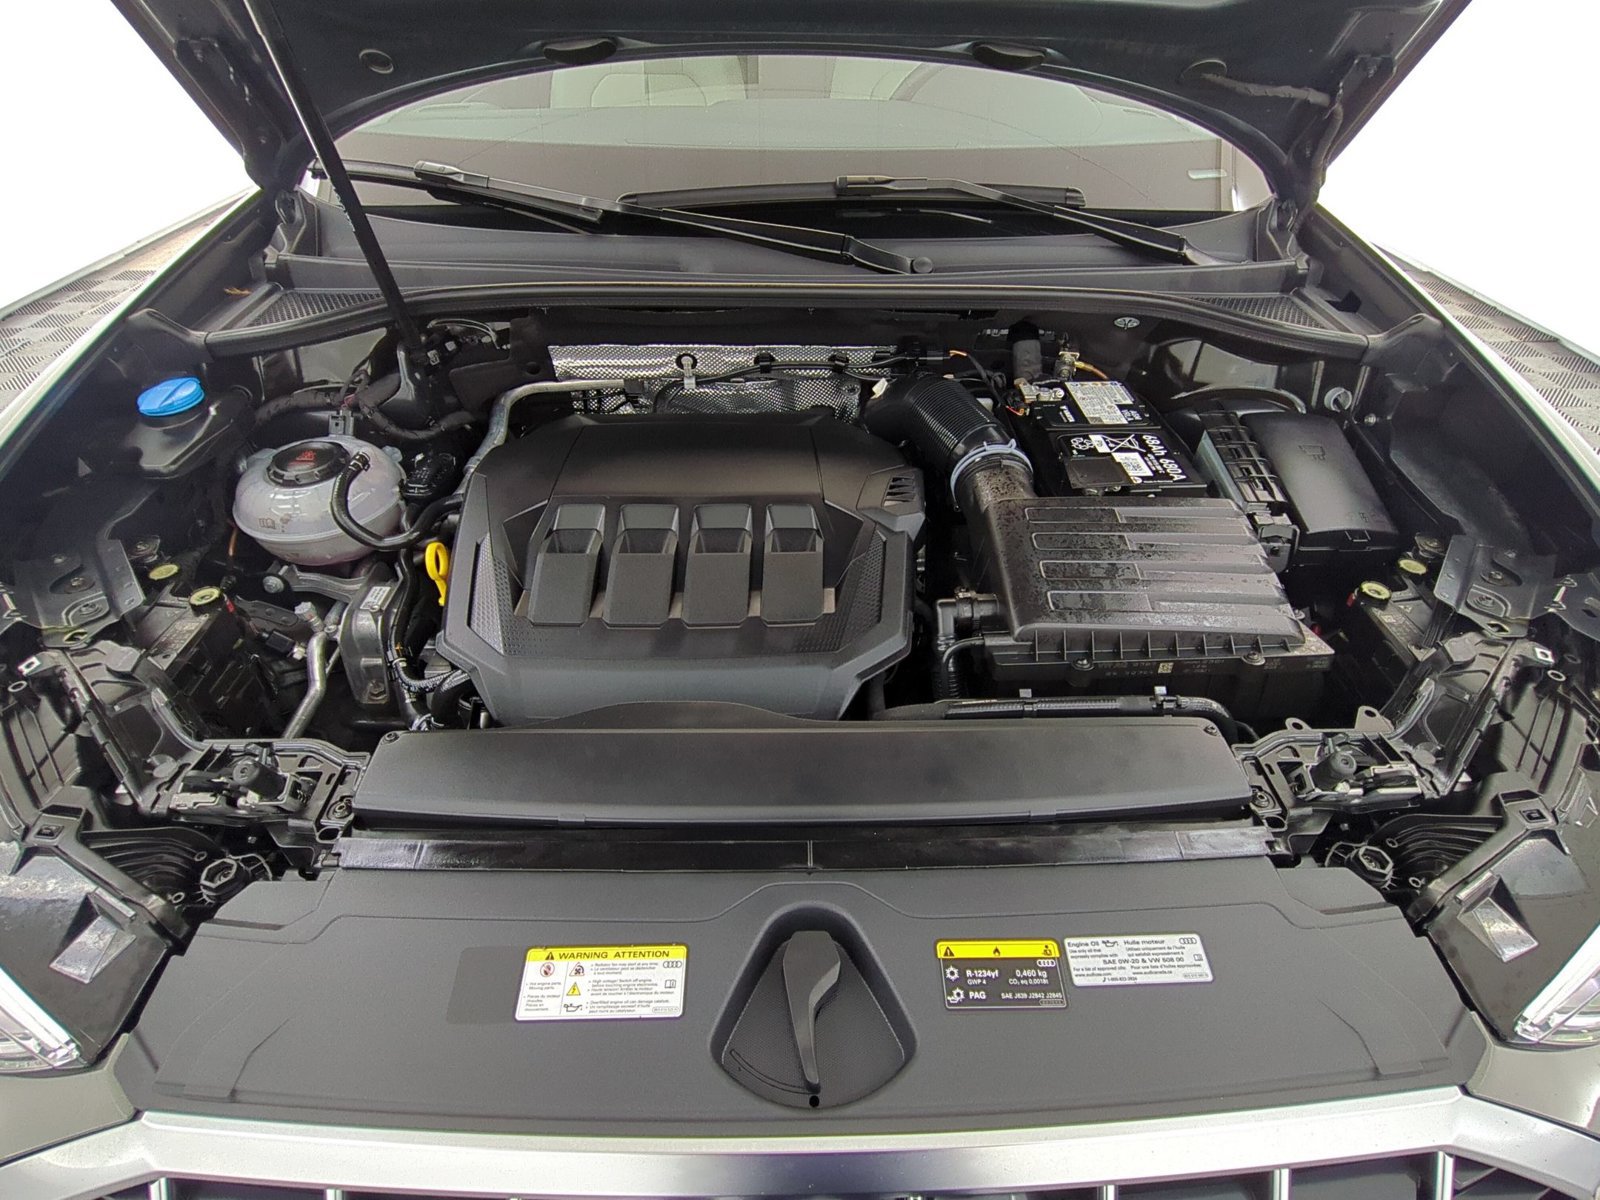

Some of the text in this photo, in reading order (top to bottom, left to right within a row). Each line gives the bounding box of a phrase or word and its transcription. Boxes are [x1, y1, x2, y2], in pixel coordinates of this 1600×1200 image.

[1142, 434, 1168, 456] 68Ah
[1159, 457, 1187, 481] 680A
[559, 950, 670, 960] WARNING ATTENTION
[966, 969, 999, 979] R-1234yf
[1037, 970, 1047, 978] kg
[969, 991, 987, 1000] PAG
